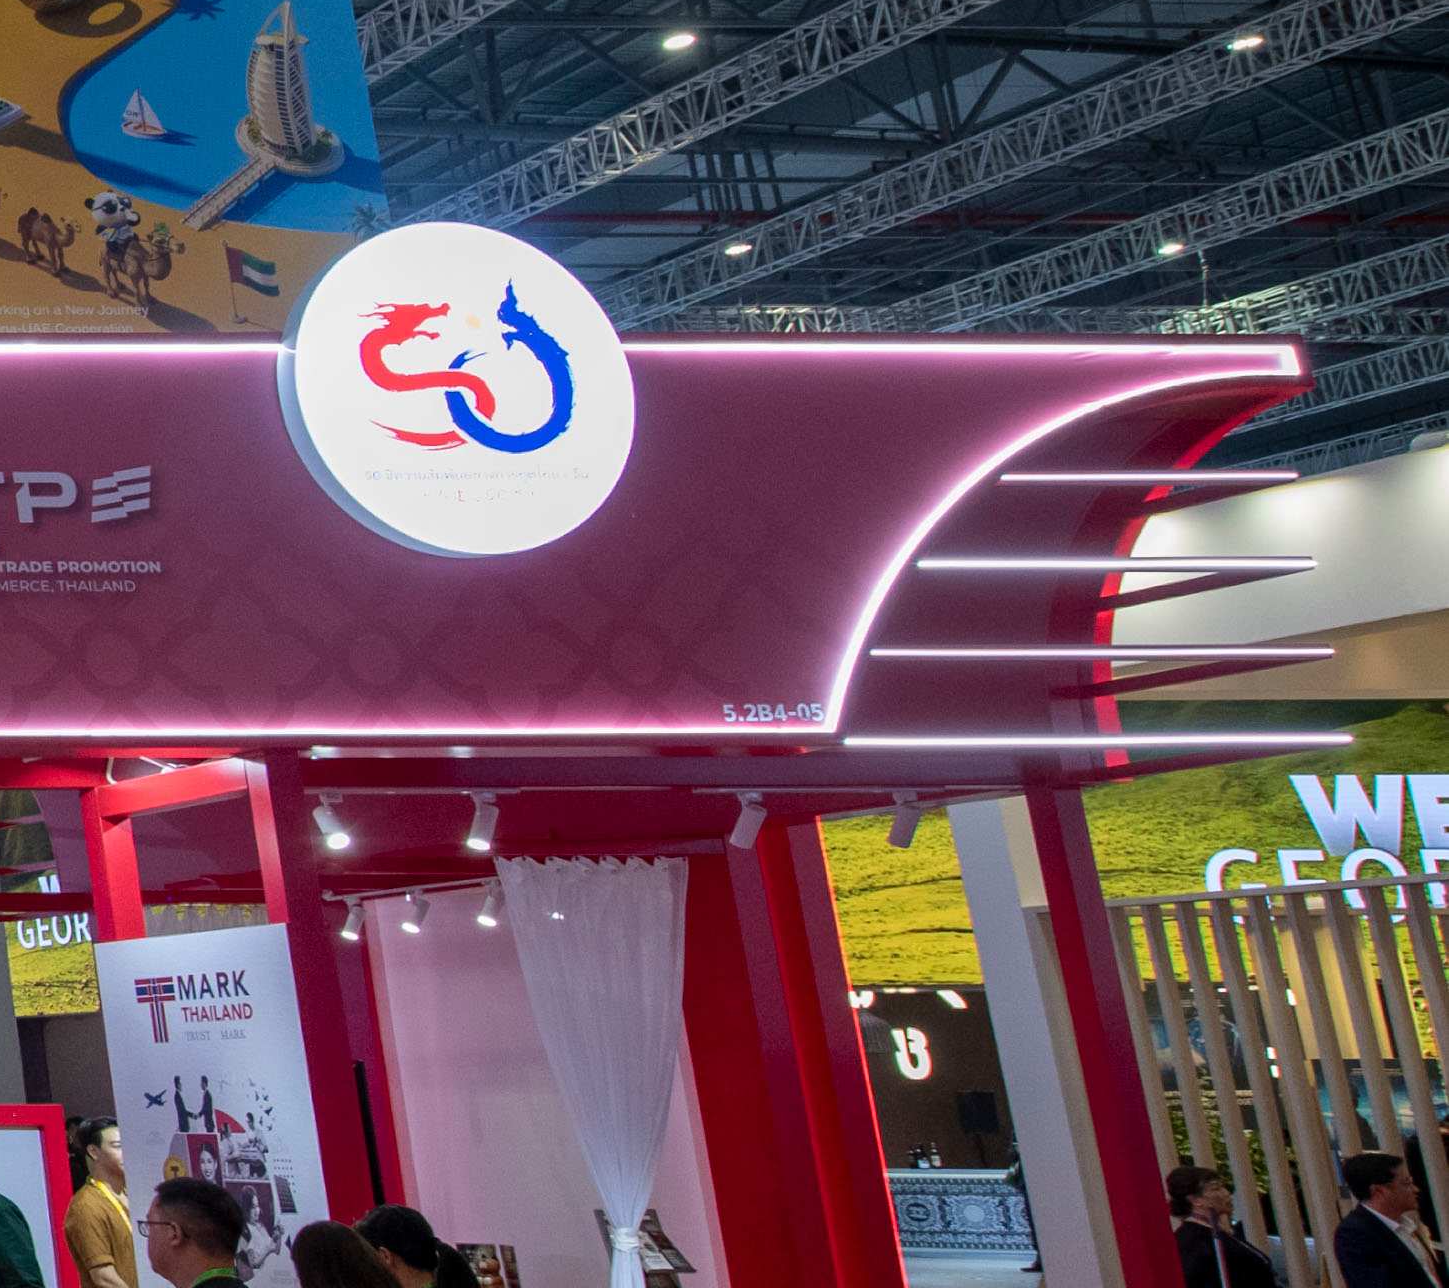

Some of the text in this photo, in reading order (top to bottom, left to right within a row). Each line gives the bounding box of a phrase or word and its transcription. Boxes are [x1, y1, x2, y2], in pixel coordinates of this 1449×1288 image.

[33, 307, 51, 316] on
[54, 308, 63, 316] a
[66, 304, 94, 316] New
[97, 304, 150, 319] Journey
[57, 560, 162, 574] PROMOTION
[57, 580, 137, 593] THAILAND
[722, 703, 825, 722] 5.2B4-05
[177, 970, 250, 1000] MARK
[180, 1002, 254, 1023] THAILAND
